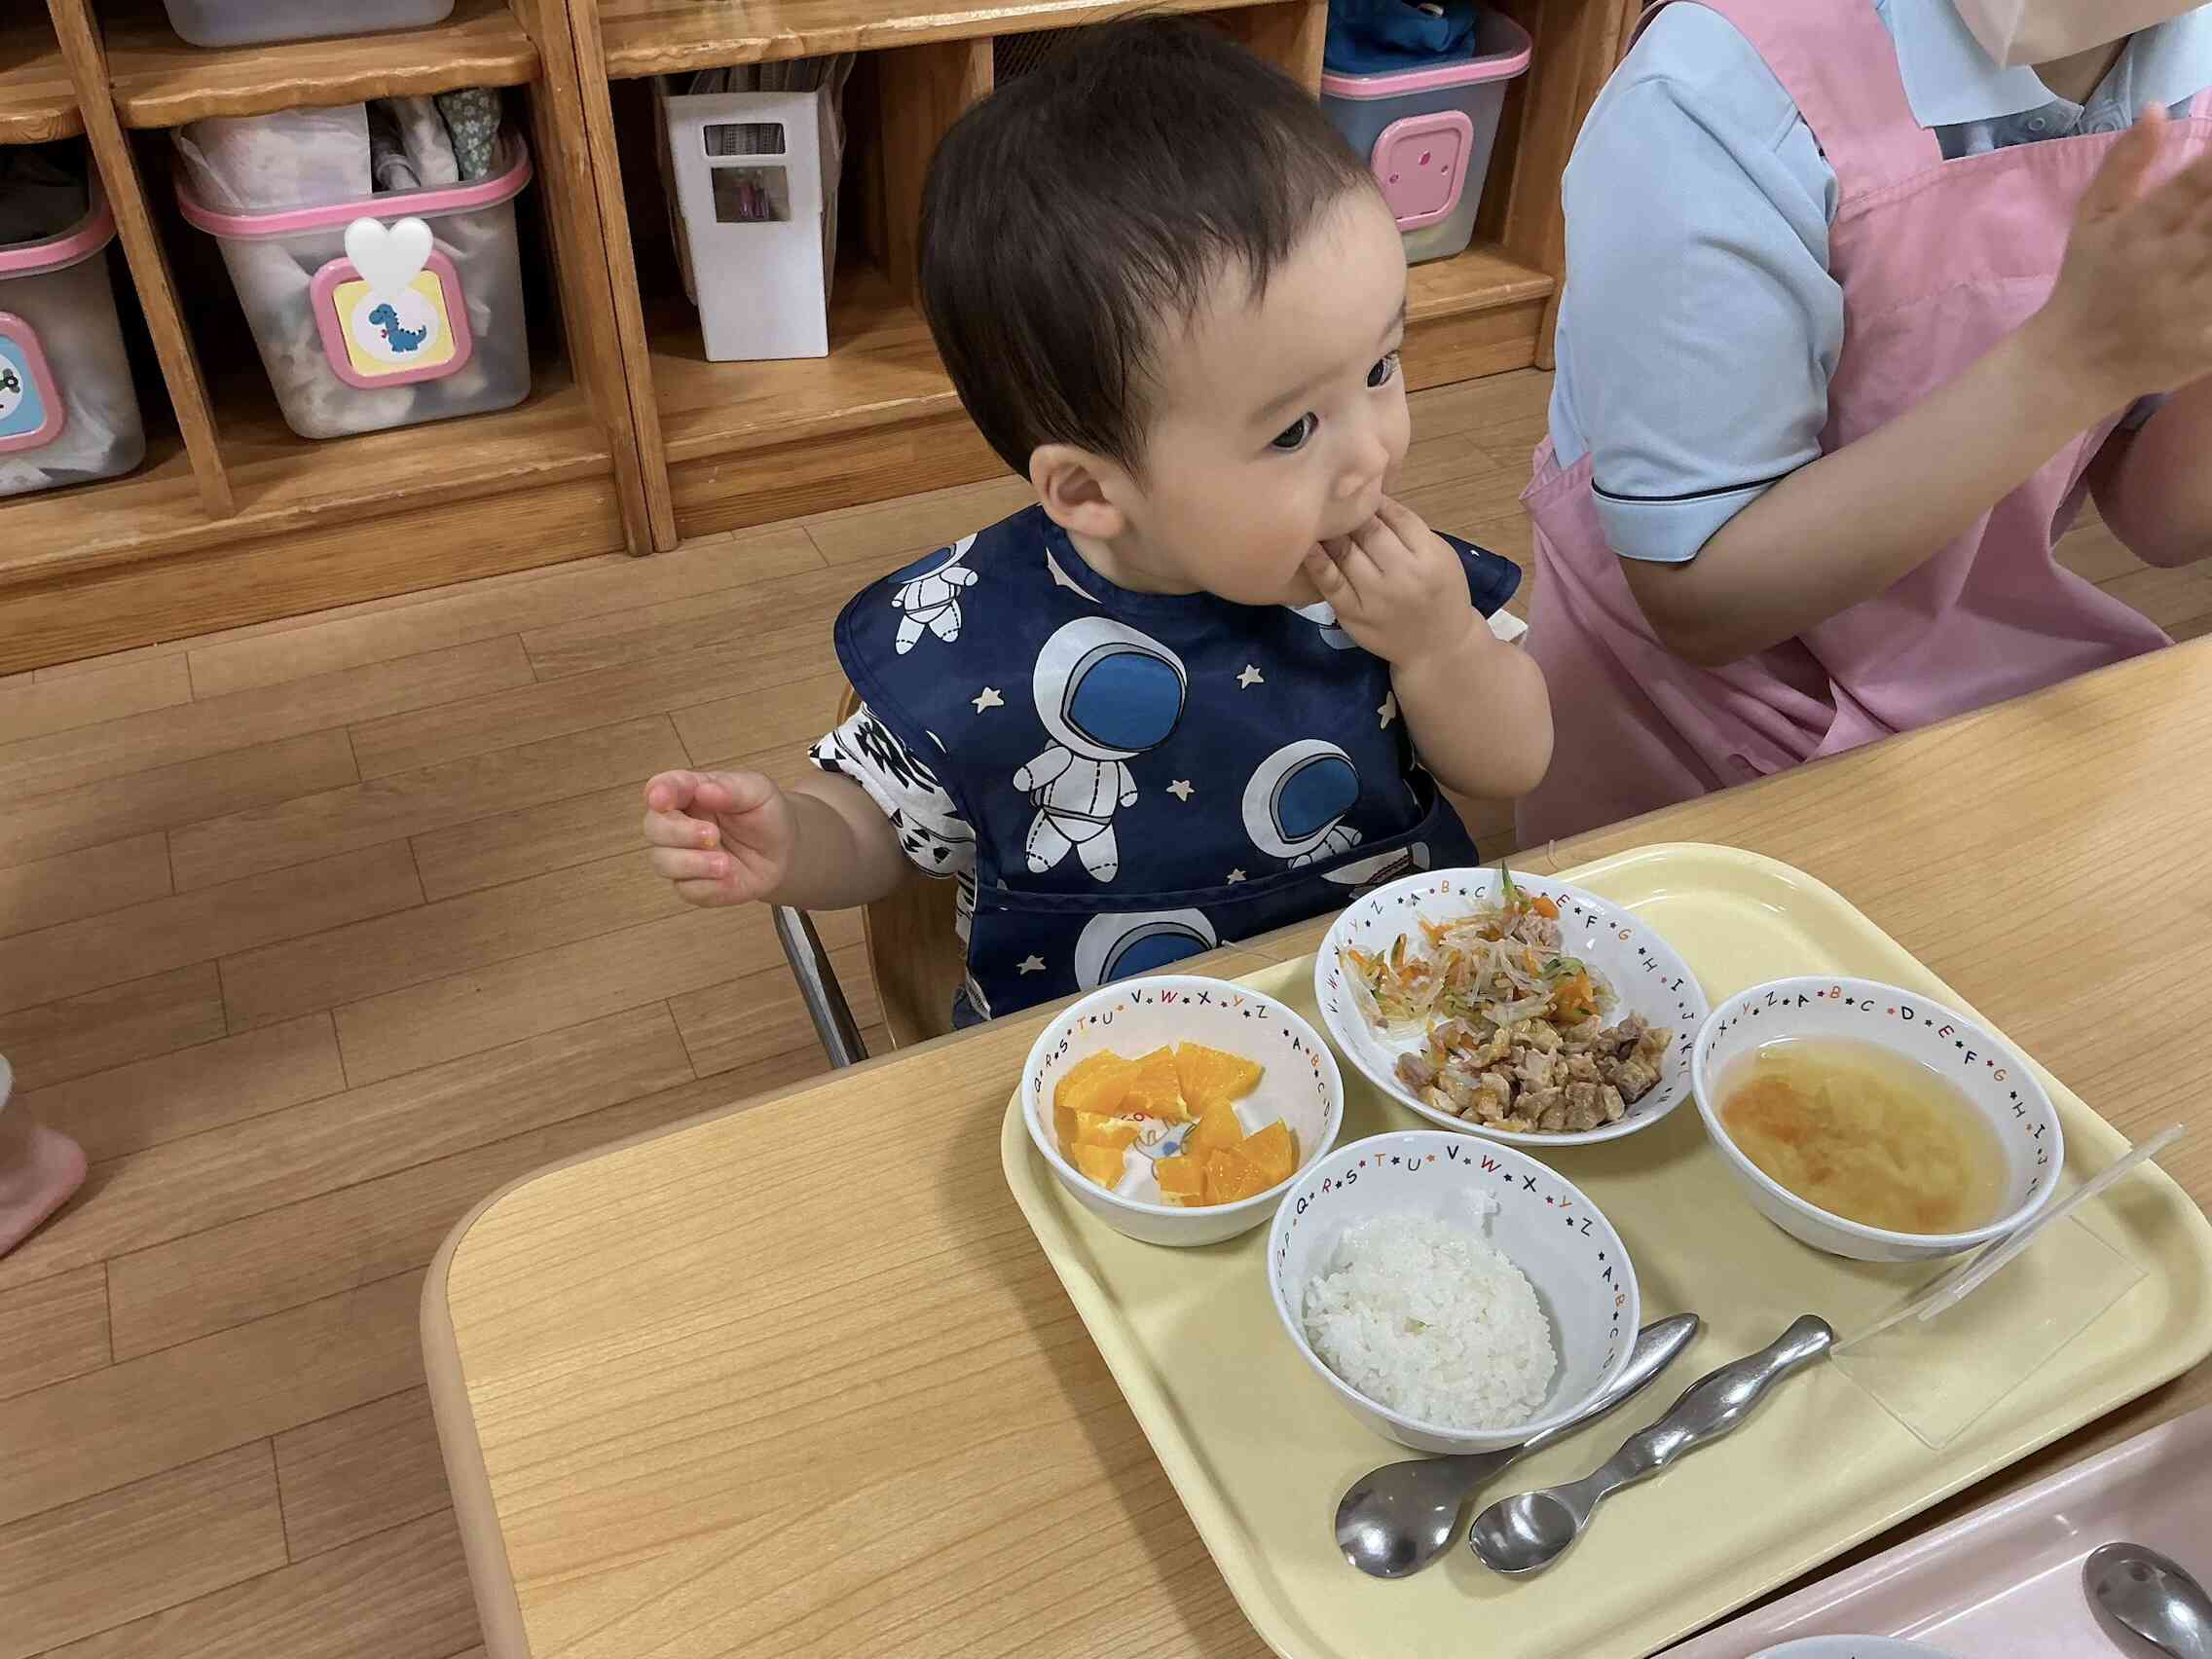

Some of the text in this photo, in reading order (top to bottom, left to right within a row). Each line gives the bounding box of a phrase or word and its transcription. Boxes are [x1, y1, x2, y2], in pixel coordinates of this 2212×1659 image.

[1371, 901, 1383, 914] Z
[1411, 893, 1421, 906] A
[1442, 880, 1450, 893] B
[1474, 886, 1486, 898] C
[1556, 894, 1570, 908] E
[1586, 915, 1598, 929] F
[1618, 929, 1632, 940] G
[1642, 957, 1658, 973] H
[1671, 978, 1684, 992] I
[1046, 1053, 1051, 1067] R
[1059, 1039, 1068, 1053] S
[1077, 1016, 1087, 1029] T
[1102, 1012, 1113, 1025] U
[1131, 989, 1142, 1004] V
[1161, 989, 1179, 1004] W
[1197, 991, 1212, 1006] X
[1233, 995, 1245, 1007] Y
[1255, 1005, 1269, 1019] Z
[1292, 1036, 1301, 1051] A
[1317, 1082, 1325, 1094] C
[1765, 991, 1778, 1007] Z
[1797, 994, 1810, 1009] A
[1830, 985, 1842, 999] B
[1861, 1000, 1875, 1012] C
[1901, 1006, 1915, 1020] D
[1938, 1025, 1955, 1039] E
[1964, 1051, 1977, 1065] F
[1993, 1069, 2007, 1082] G
[2012, 1101, 2026, 1119] H
[2034, 1124, 2046, 1139] I
[1296, 1198, 1309, 1215] Q
[1321, 1178, 1332, 1194] R
[1346, 1169, 1357, 1185] S
[1375, 1153, 1386, 1167] T
[1408, 1158, 1421, 1172] U
[1447, 1145, 1459, 1161] V
[1481, 1155, 1502, 1173] W
[1523, 1175, 1536, 1193] X
[1559, 1195, 1573, 1208] Y
[1580, 1217, 1594, 1237] Z
[1603, 1266, 1612, 1283] A
[1609, 1327, 1619, 1339] C
